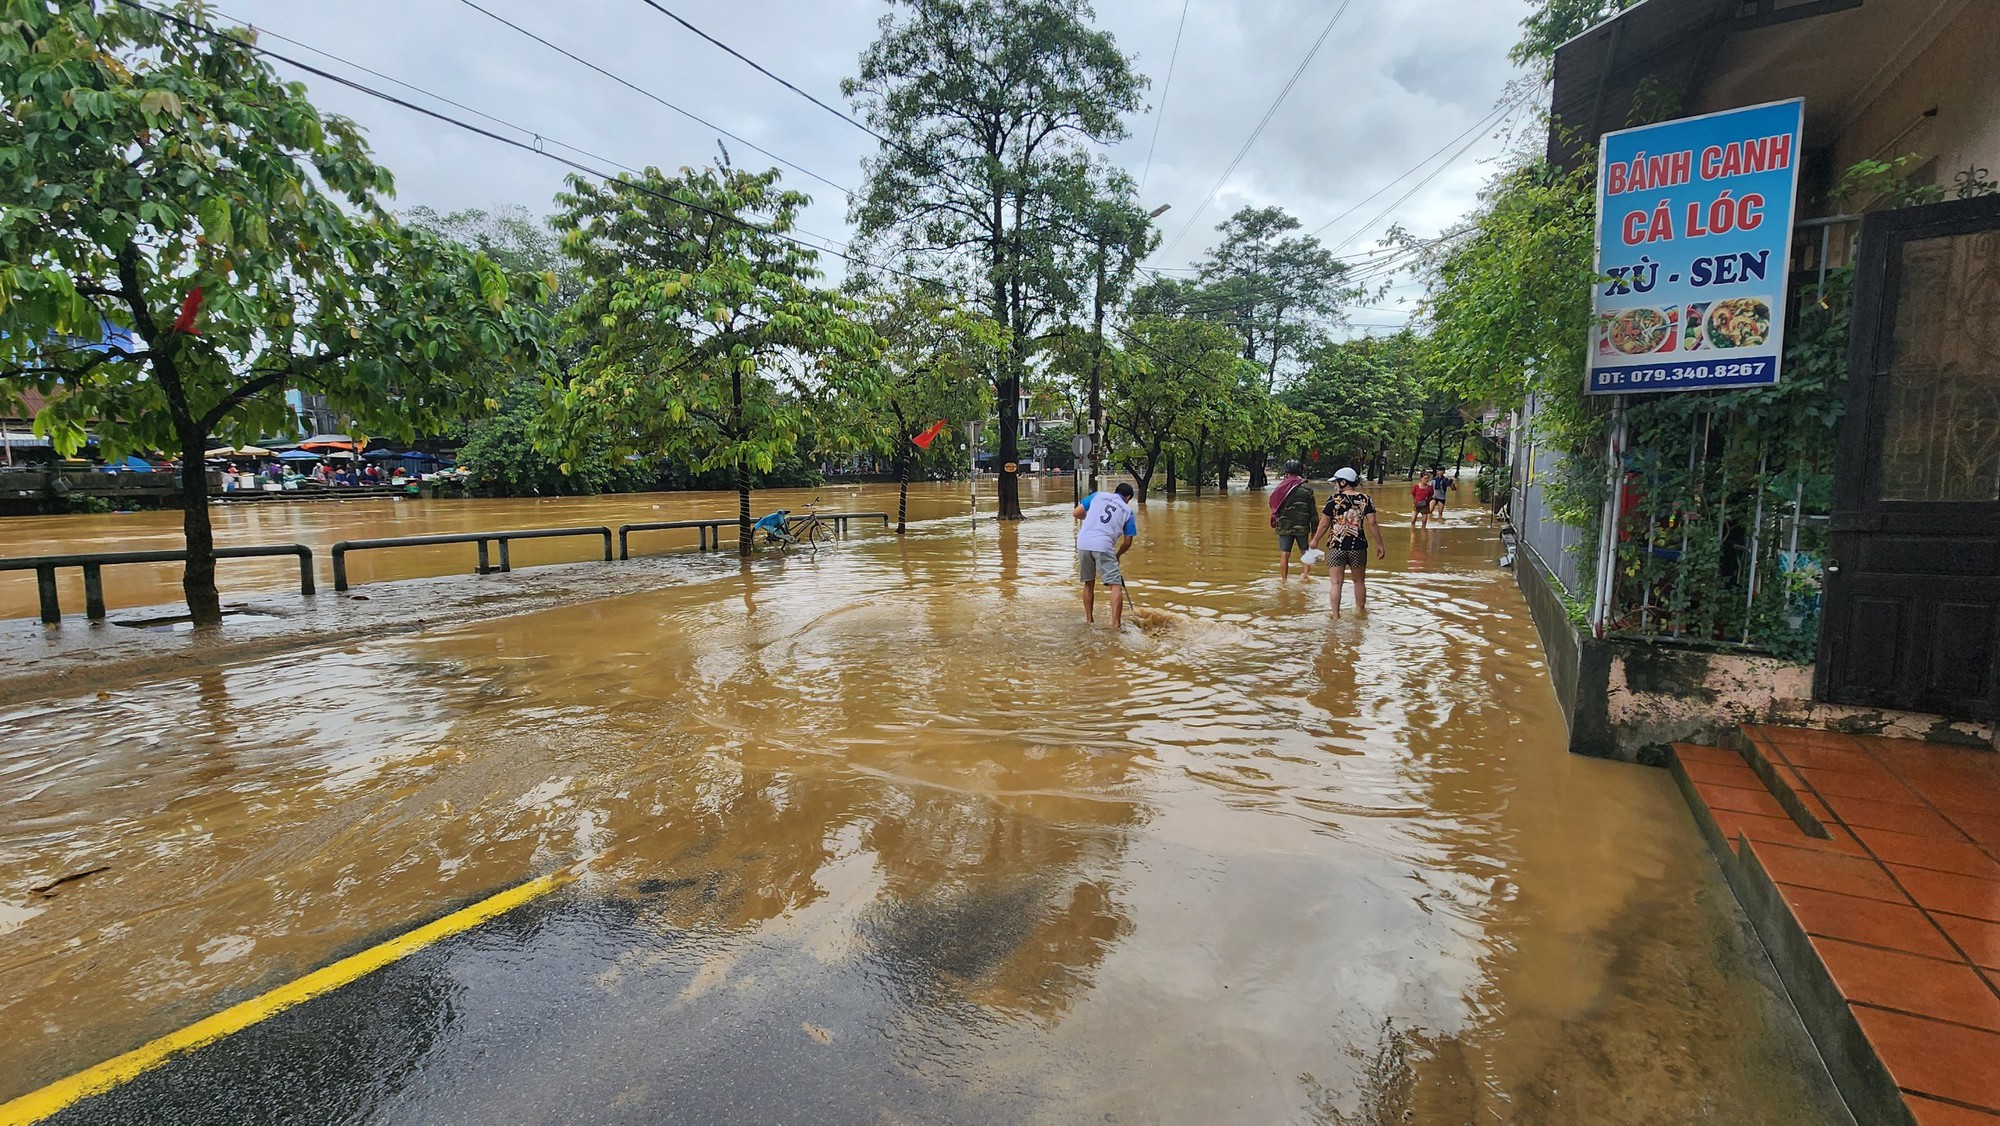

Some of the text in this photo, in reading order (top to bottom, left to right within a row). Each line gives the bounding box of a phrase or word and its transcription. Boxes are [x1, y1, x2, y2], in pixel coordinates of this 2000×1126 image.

[1608, 134, 1791, 196] BÁNH CANH
[1622, 190, 1763, 245] CÁ LÓC
[1604, 255, 1659, 296] XÙ
[1690, 250, 1769, 287] SEN
[1598, 362, 1765, 385] ĐT: 079.340.8267
[1100, 504, 1117, 524] 5
